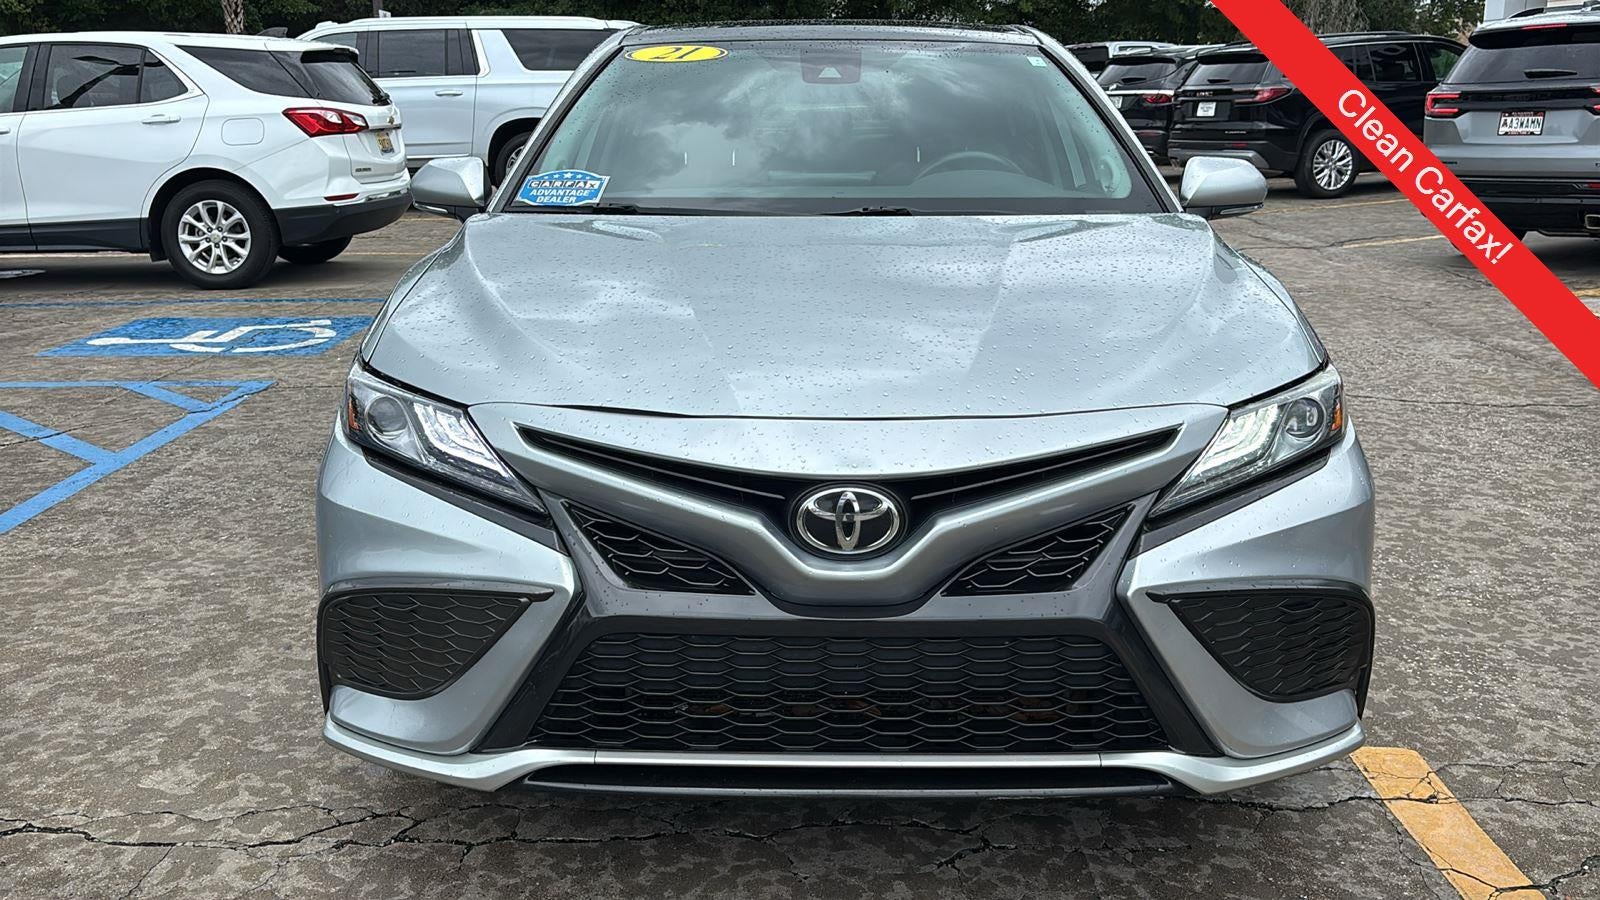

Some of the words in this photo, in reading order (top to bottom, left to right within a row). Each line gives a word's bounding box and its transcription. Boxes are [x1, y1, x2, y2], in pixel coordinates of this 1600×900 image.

[648, 47, 703, 59] 21
[529, 180, 599, 189] CARFAX
[529, 189, 591, 197] ADVANTAGE
